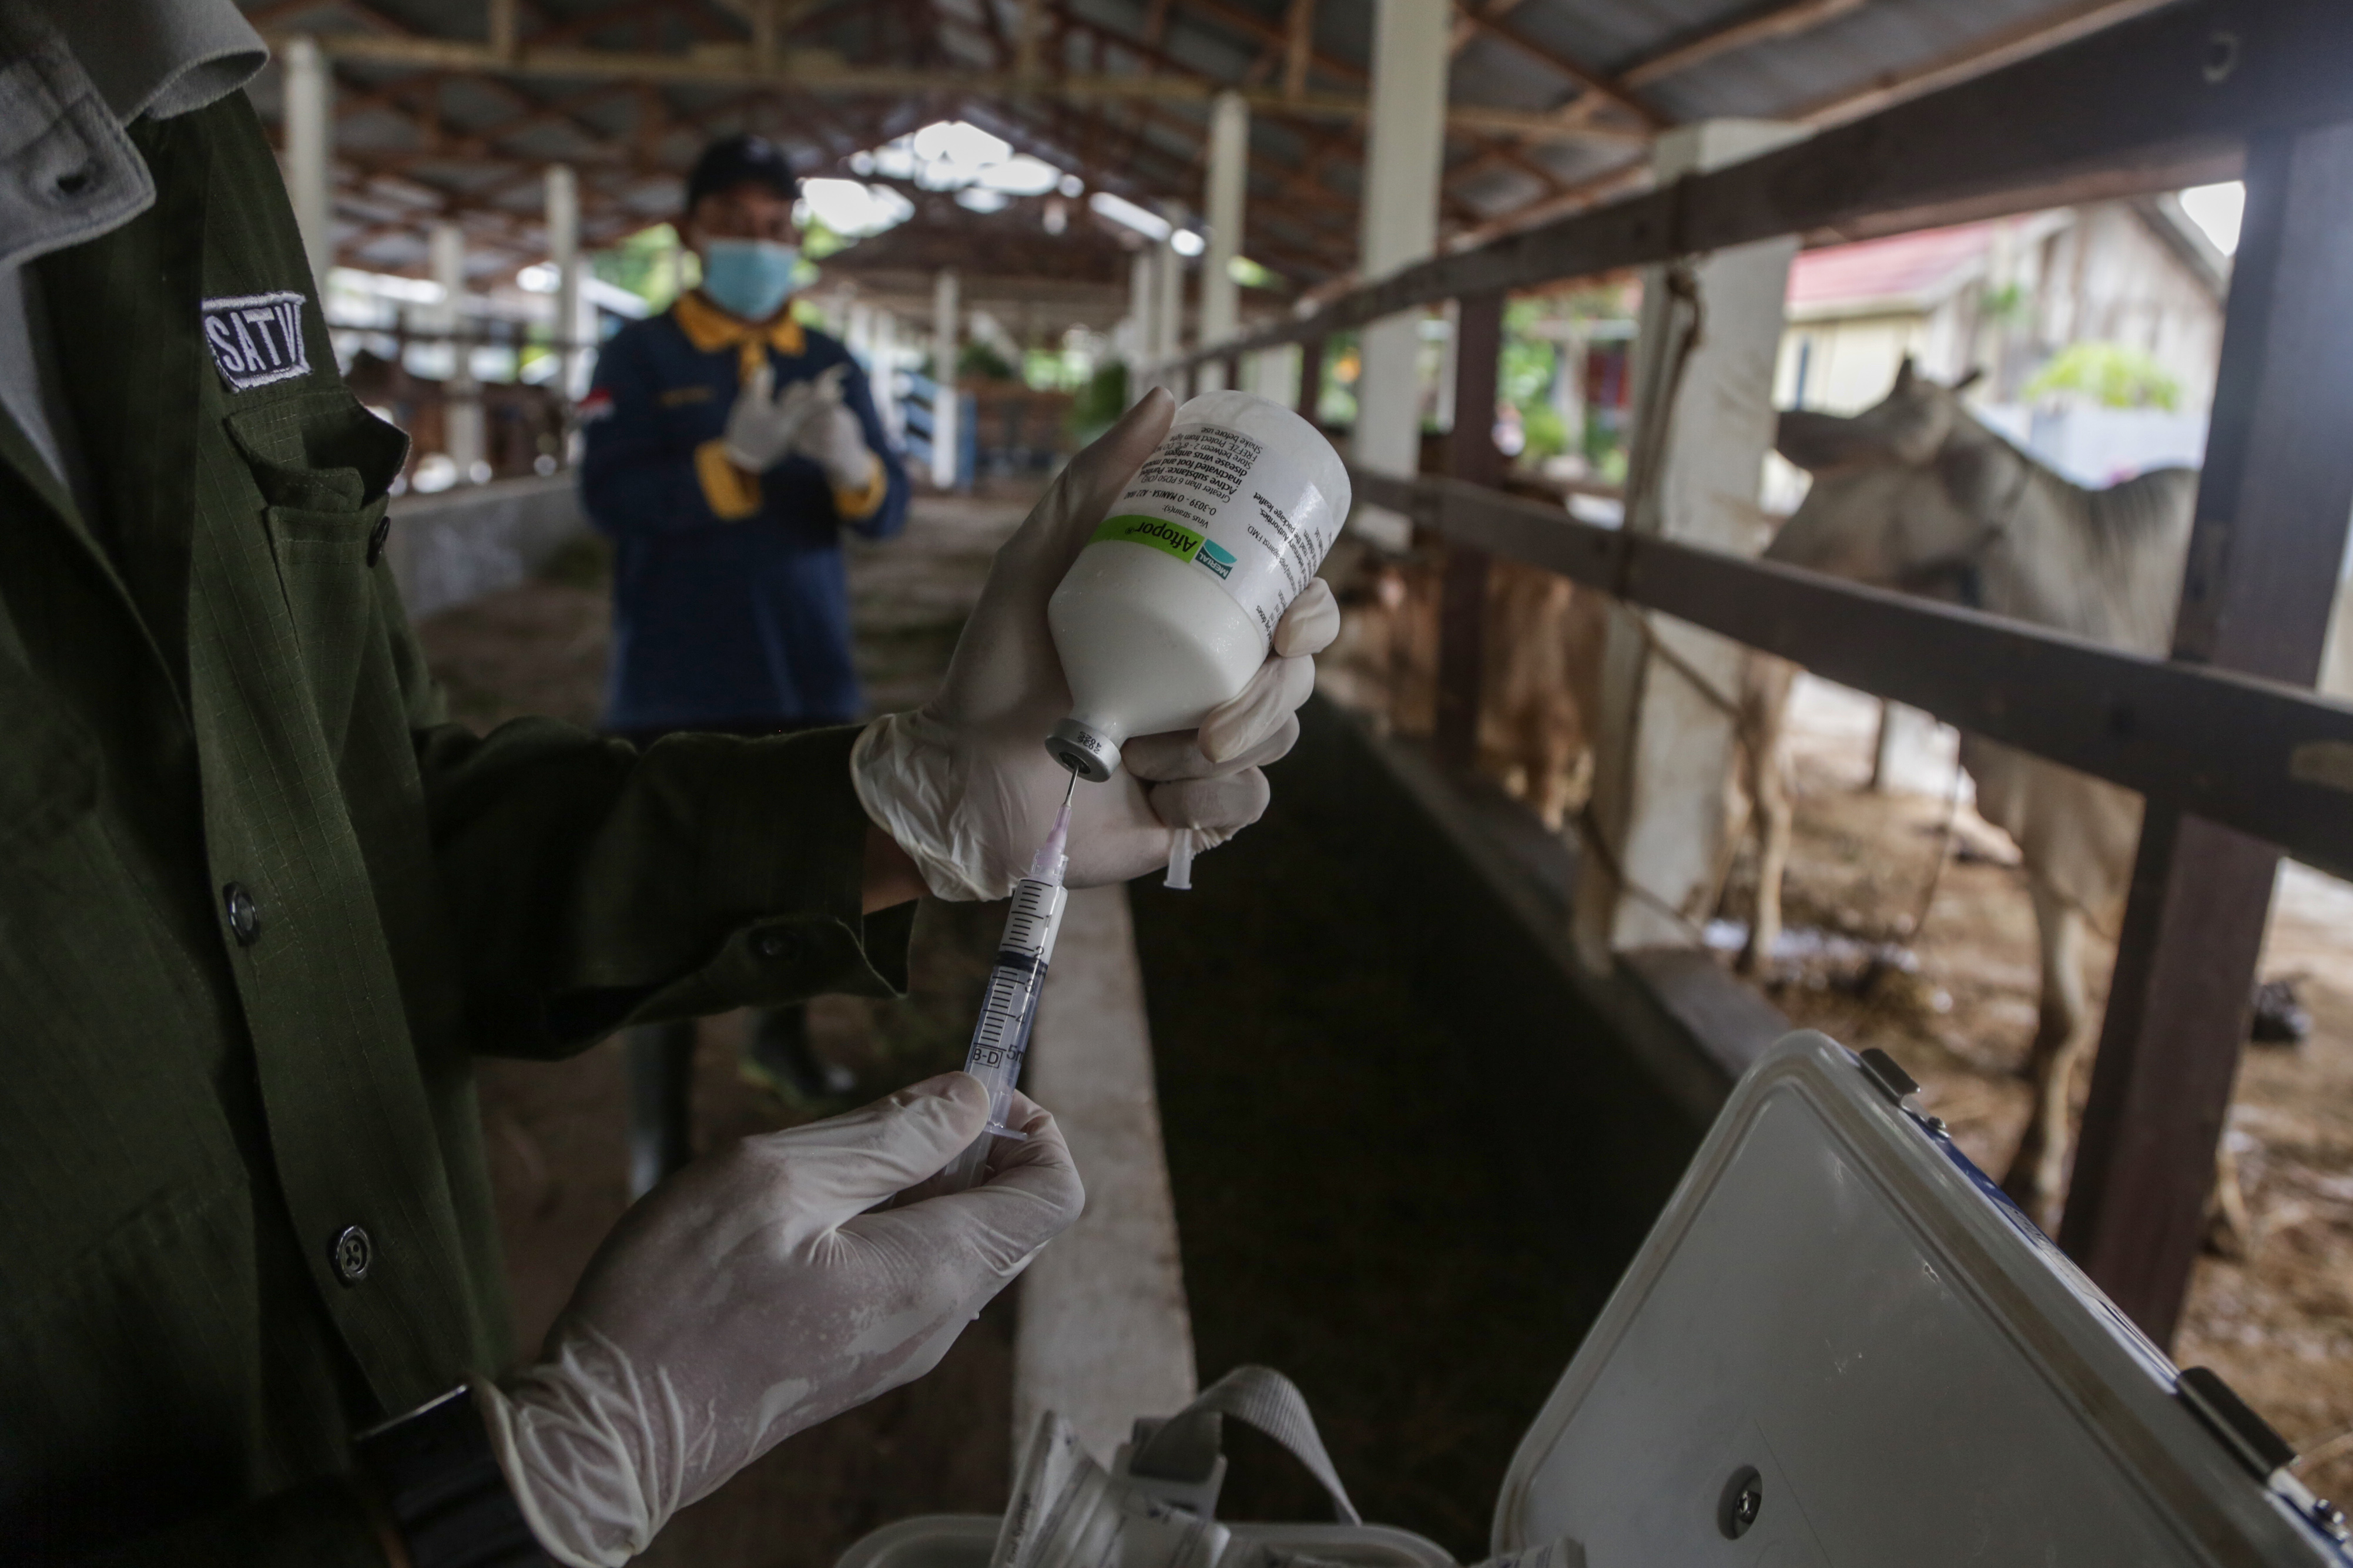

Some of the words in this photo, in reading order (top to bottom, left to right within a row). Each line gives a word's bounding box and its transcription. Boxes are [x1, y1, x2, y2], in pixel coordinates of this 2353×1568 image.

[1201, 435, 1226, 448] Protect
[1215, 429, 1239, 443] before
[1201, 445, 1232, 459] between
[1240, 438, 1262, 454] Shake
[1177, 459, 1194, 468] foot
[1193, 452, 1213, 462] virus
[1233, 455, 1252, 469] Store
[1165, 467, 1209, 481] substance:
[1215, 458, 1247, 476] disease
[1158, 475, 1178, 484] PD50
[1194, 462, 1242, 487] inactivated
[1185, 479, 1202, 489] than
[1210, 478, 1237, 495] Active
[1152, 490, 1177, 500] MANISA
[1202, 486, 1230, 503] Greater
[1253, 492, 1273, 512] leaflet
[1162, 505, 1191, 518] strain(s):
[1192, 515, 1208, 528] Virus
[1260, 508, 1288, 540] Authorities.
[1273, 509, 1295, 533] package
[1248, 524, 1263, 541] FMD.
[1262, 538, 1279, 557] against
[1200, 553, 1228, 577] MERIAL
[1256, 606, 1266, 623] doses
[1034, 946, 1044, 961] 2
[1025, 979, 1035, 993] 3
[1015, 1012, 1025, 1025] 4
[973, 1048, 998, 1064] B-D
